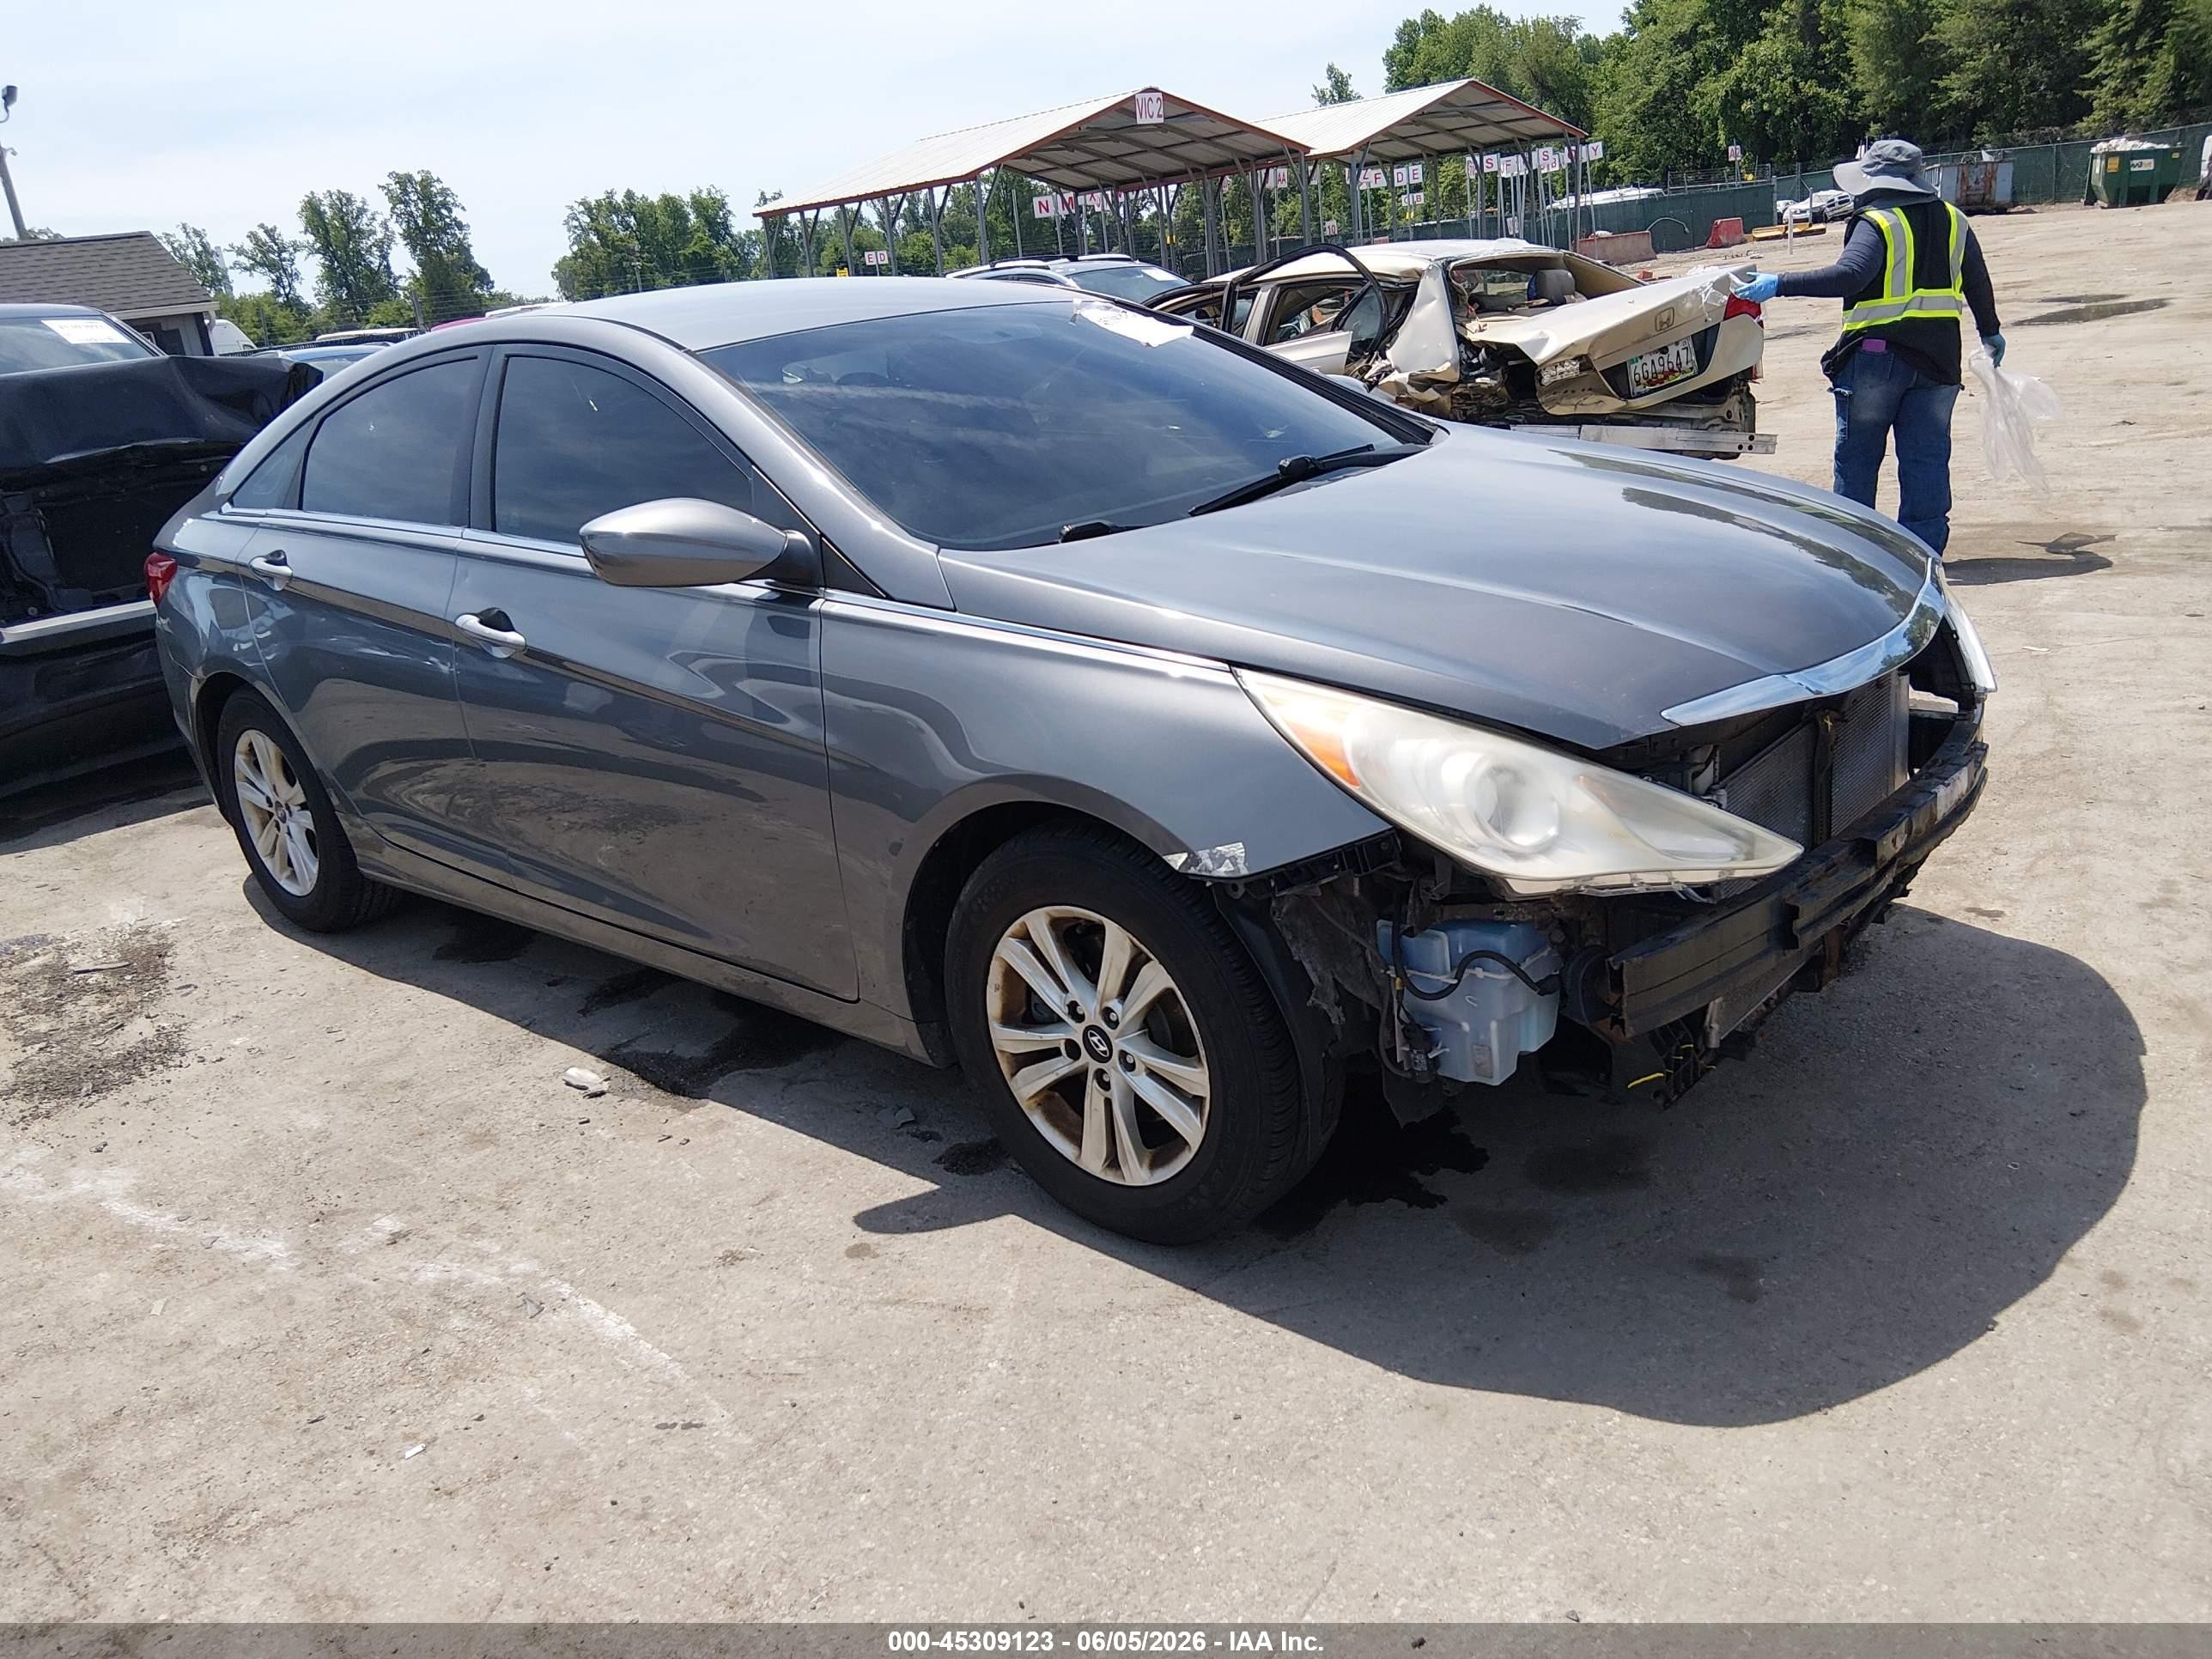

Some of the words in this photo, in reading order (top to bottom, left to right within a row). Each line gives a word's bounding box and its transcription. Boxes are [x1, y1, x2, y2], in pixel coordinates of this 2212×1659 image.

[1137, 97, 1154, 119] VIC
[1156, 97, 1163, 118] 2
[1542, 151, 1549, 161] S
[1591, 146, 1599, 156] Y
[1486, 158, 1494, 169] S
[1277, 171, 1286, 184] AA
[1374, 173, 1382, 185] F
[1396, 171, 1404, 183] D
[1412, 168, 1419, 180] E
[1037, 199, 1049, 214] N
[1327, 224, 1336, 234] 10
[867, 253, 873, 263] E
[879, 252, 885, 262] D
